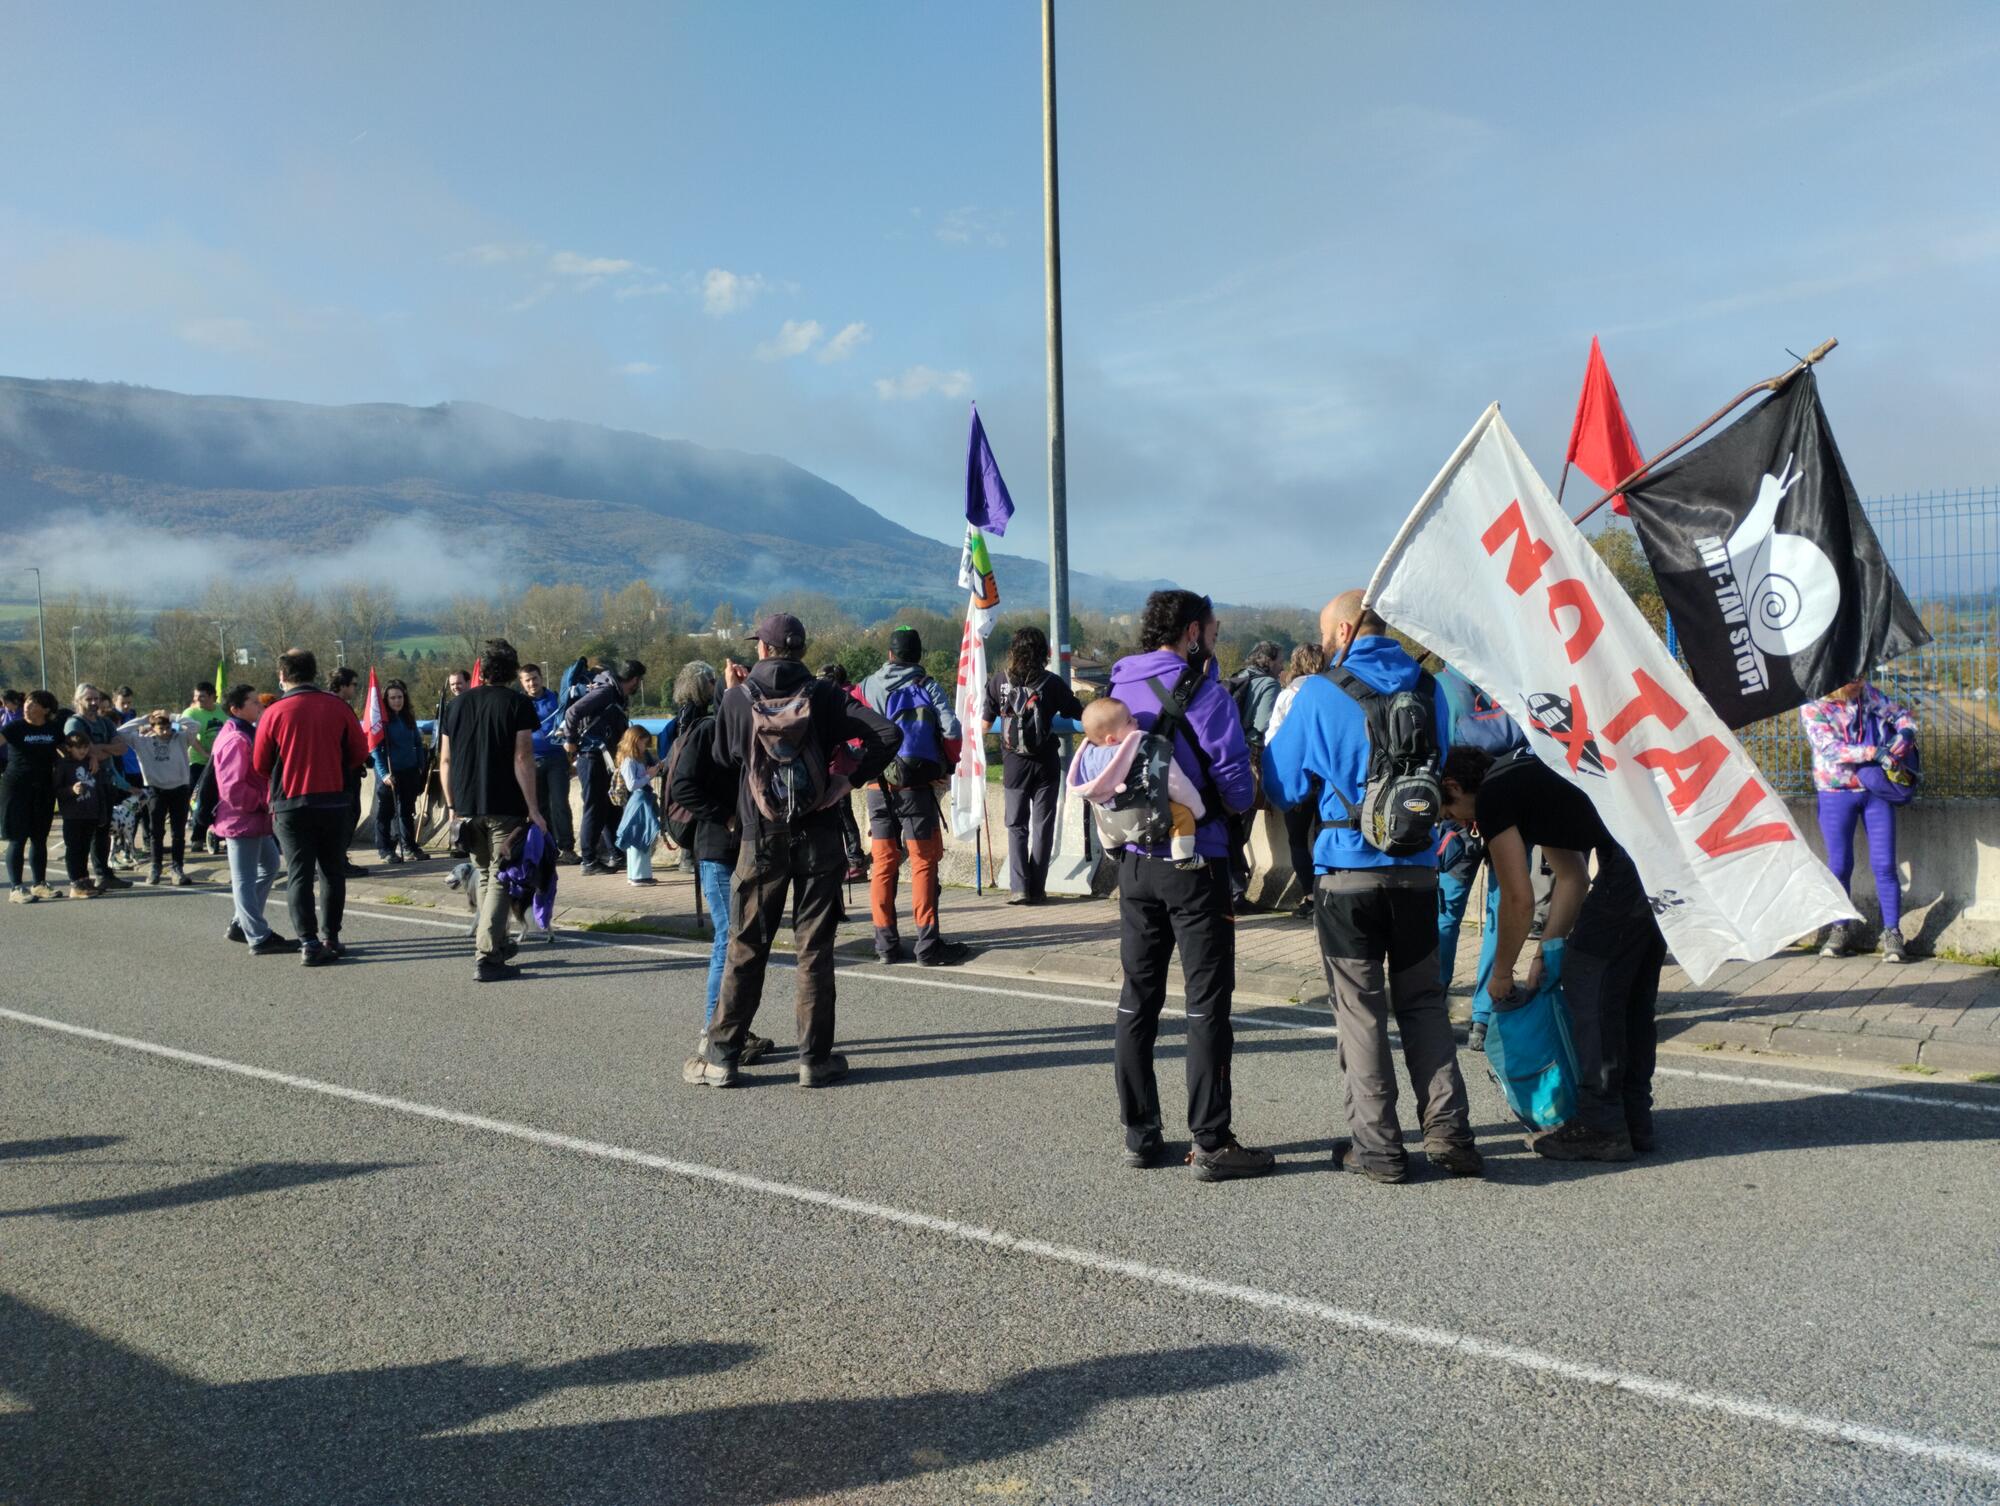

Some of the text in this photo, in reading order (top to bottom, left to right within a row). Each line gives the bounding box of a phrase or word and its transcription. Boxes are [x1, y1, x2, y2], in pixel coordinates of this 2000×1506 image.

[1480, 498, 1796, 858] NO TAV
[1694, 535, 1764, 696] AHT-TAV STOP!
